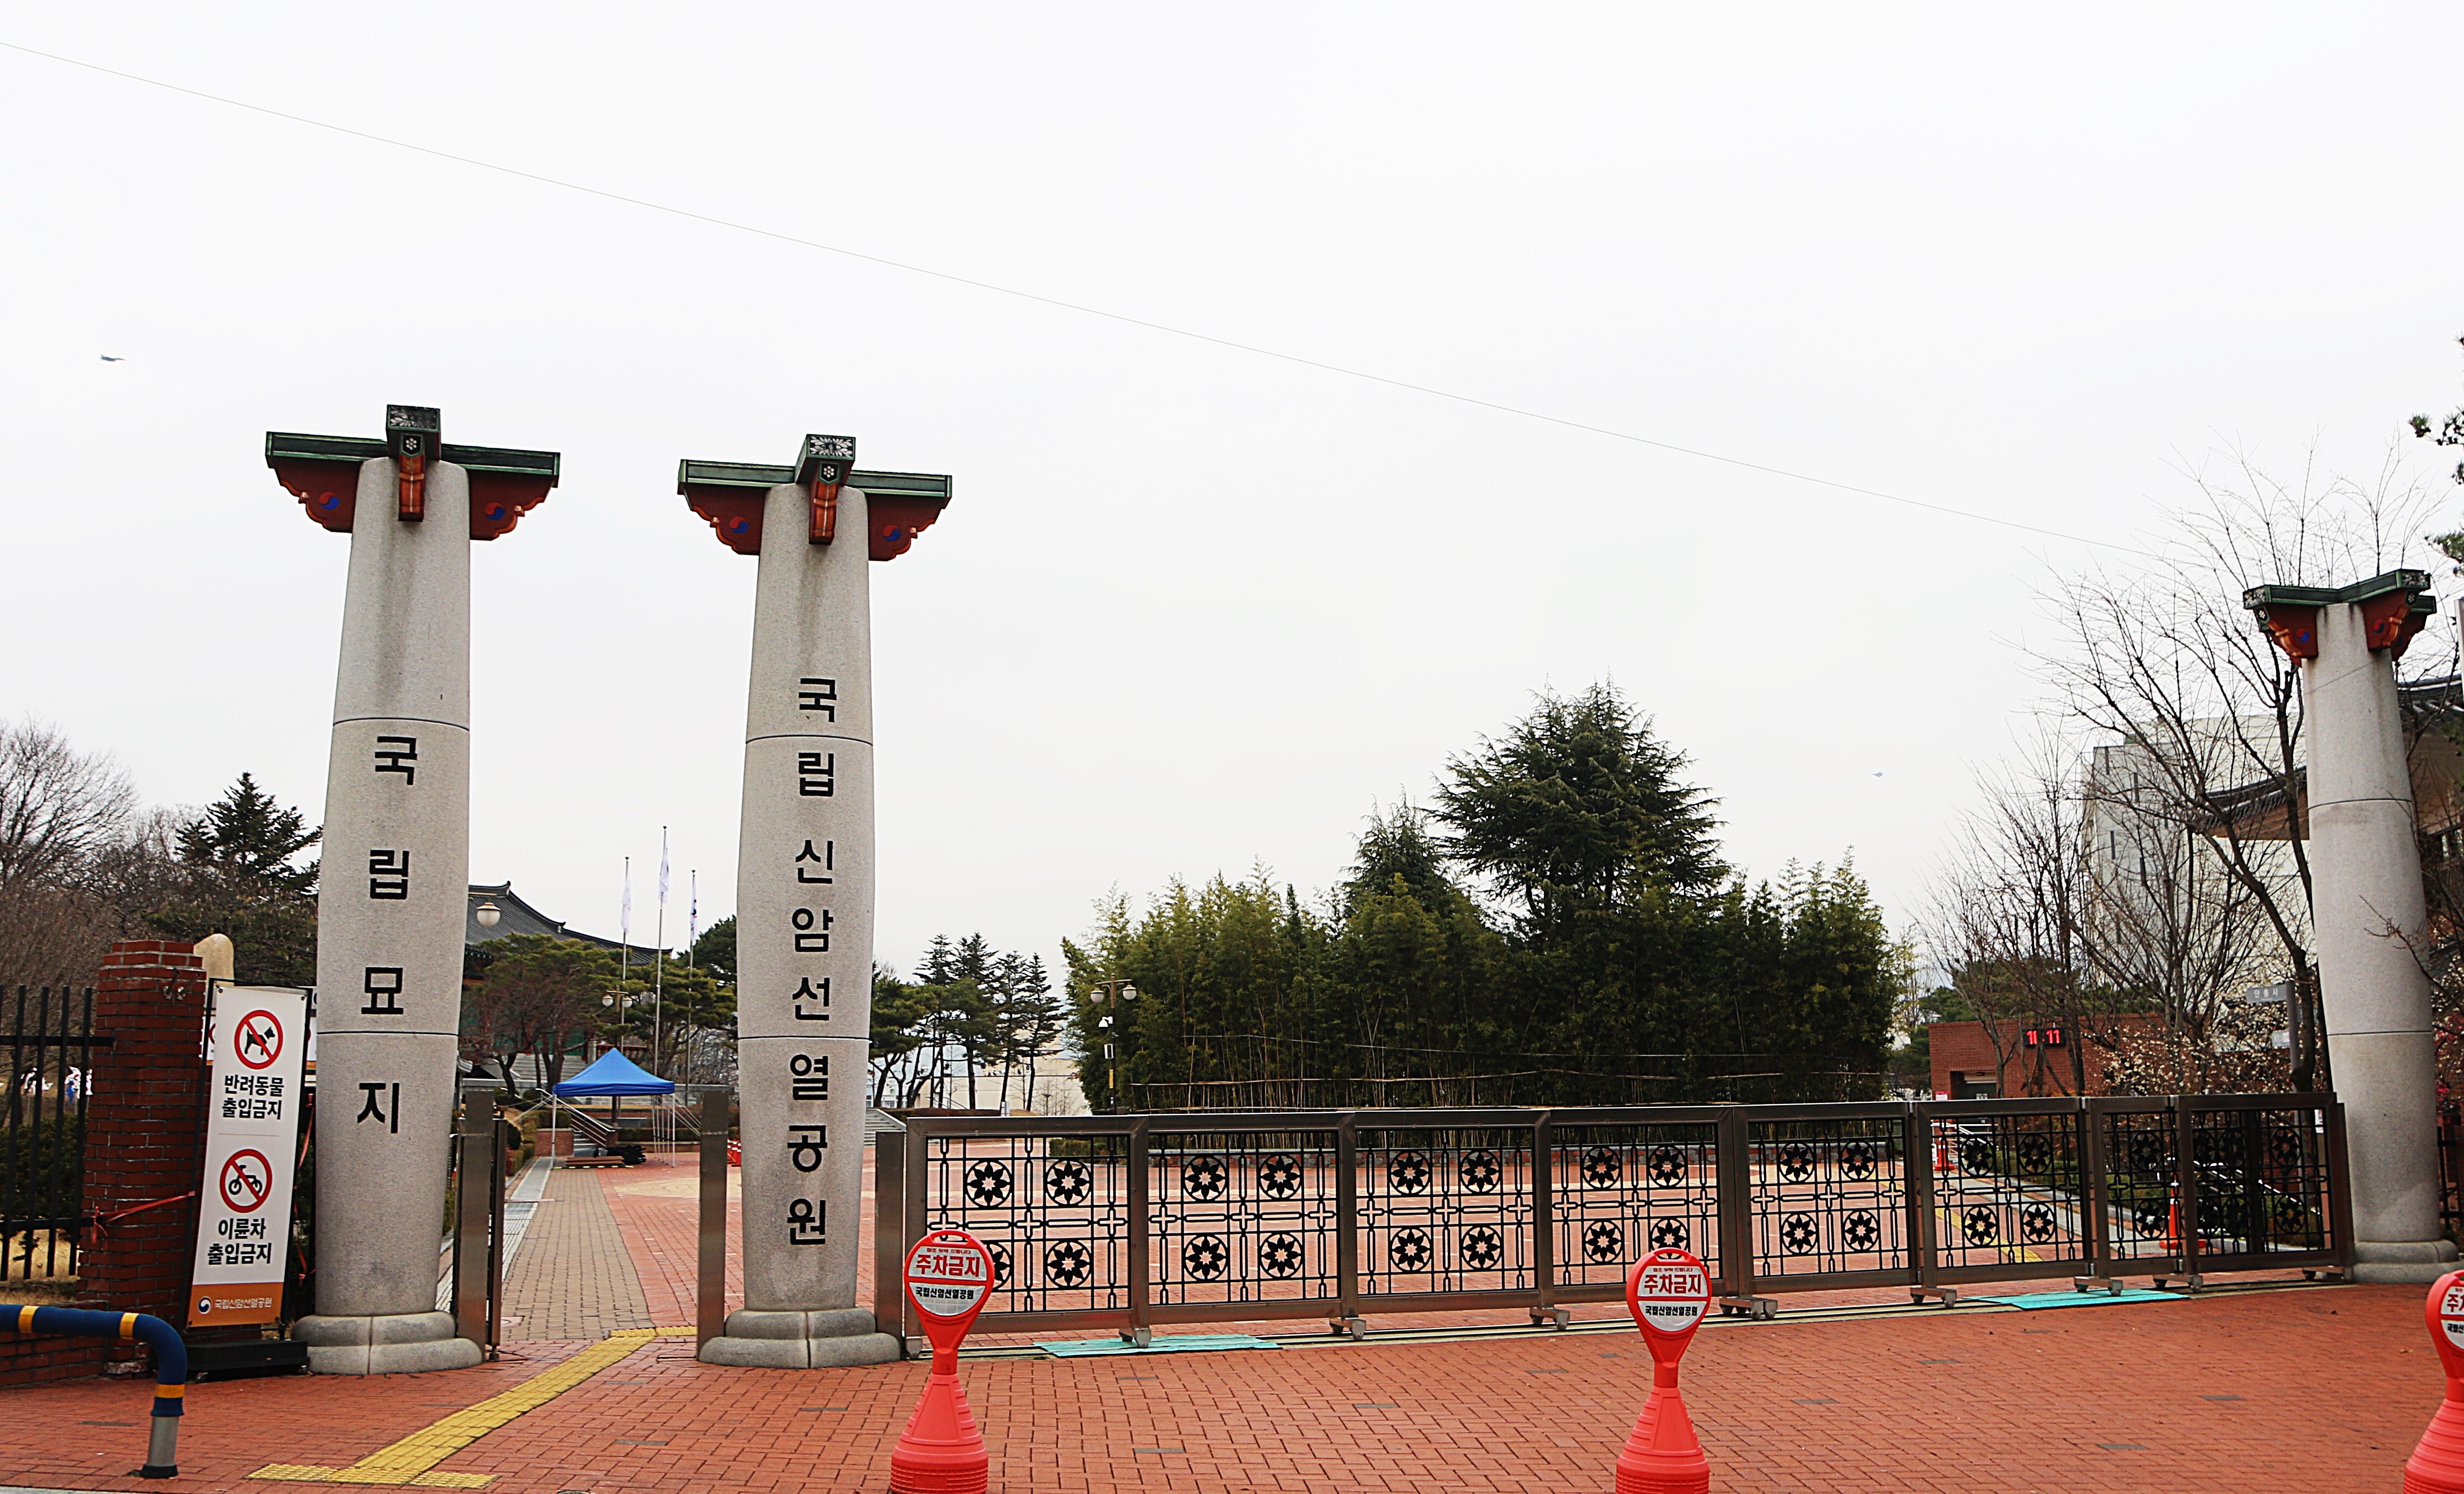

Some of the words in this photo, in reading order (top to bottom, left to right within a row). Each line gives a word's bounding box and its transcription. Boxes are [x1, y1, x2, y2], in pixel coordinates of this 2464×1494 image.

[357, 736, 418, 1134] 국립묘지
[224, 1074, 284, 1097] 반려동물
[222, 1097, 282, 1120] 출입금지
[218, 1218, 266, 1239] 이륜차
[207, 1243, 272, 1265] 출입금지
[916, 1254, 980, 1277] 주차금지
[916, 1287, 974, 1300] 국립신암선열공원
[1644, 1274, 1701, 1294] 주차금지
[215, 1297, 272, 1309] 국립신암선열공원
[1645, 1305, 1698, 1316] 국립신암선열공원
